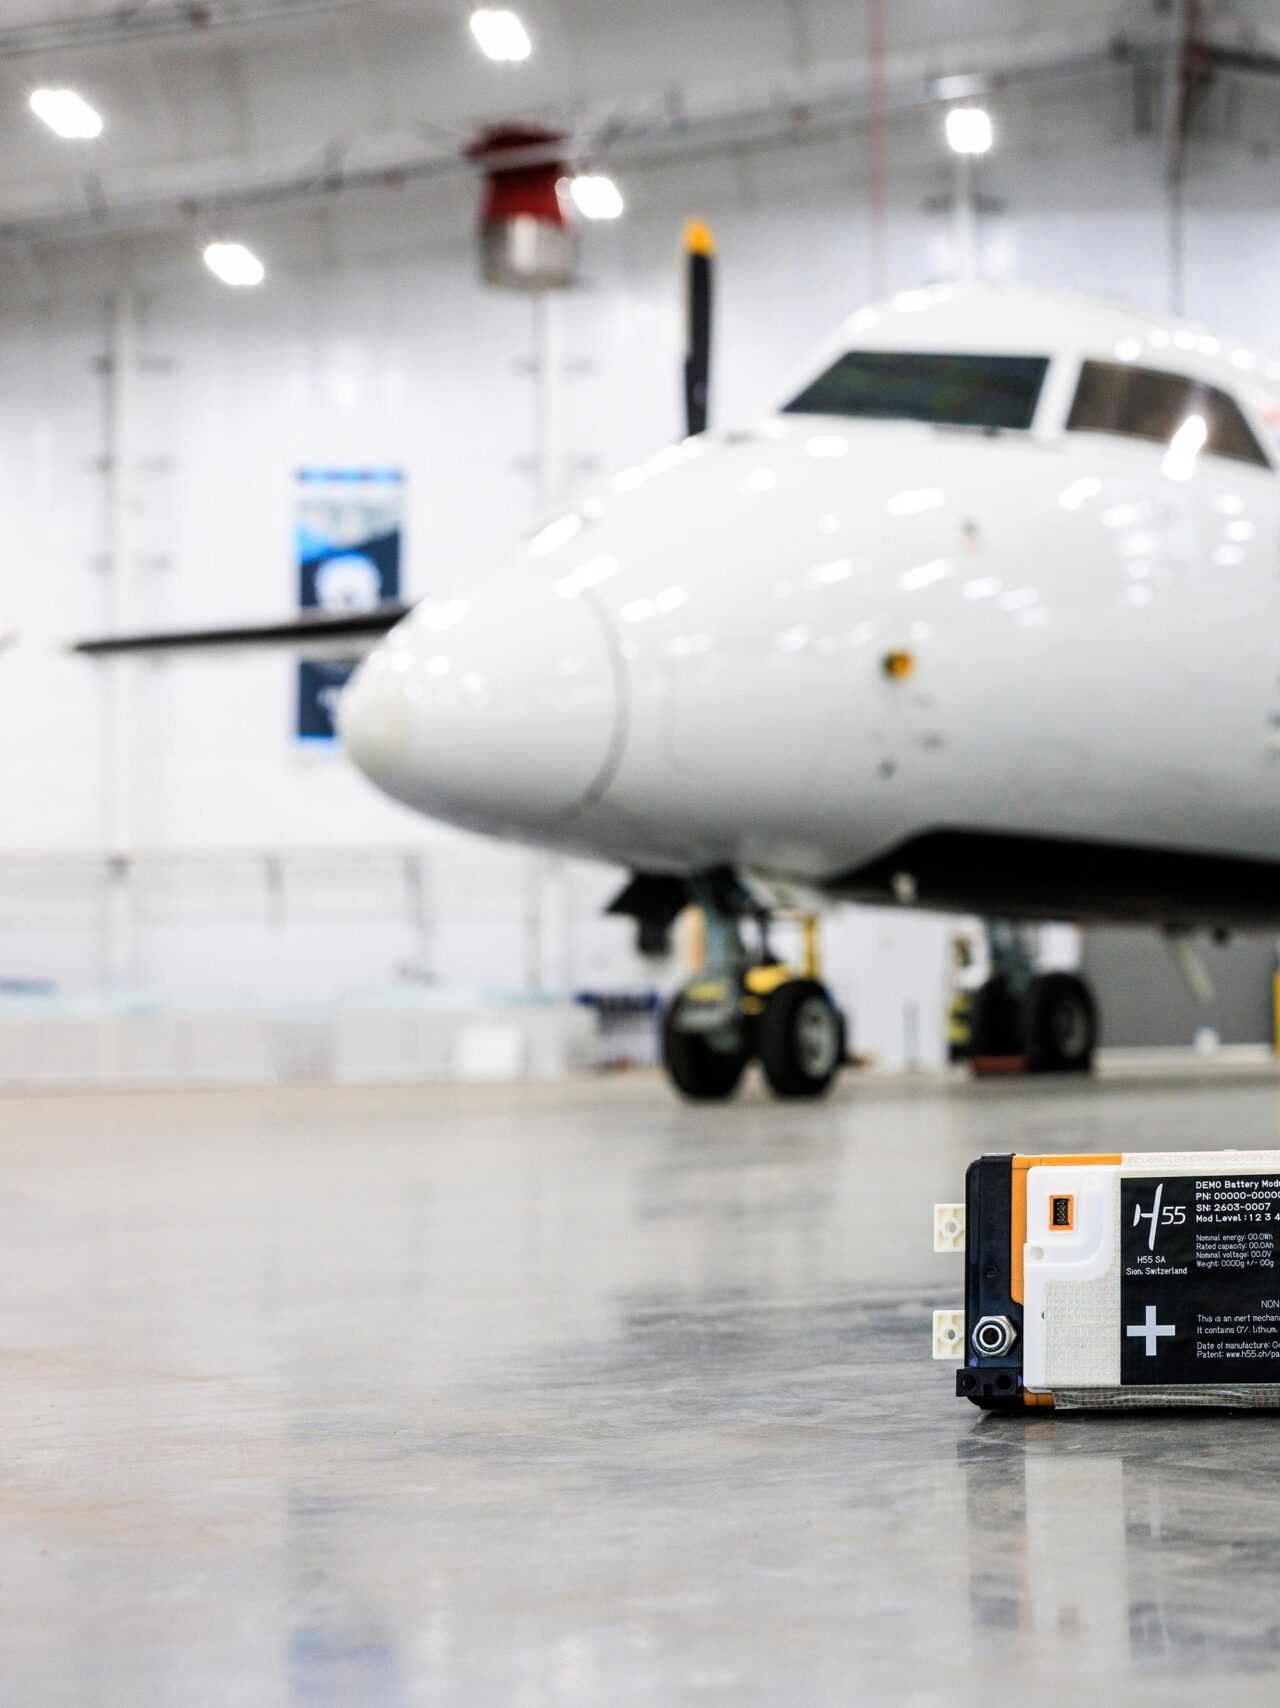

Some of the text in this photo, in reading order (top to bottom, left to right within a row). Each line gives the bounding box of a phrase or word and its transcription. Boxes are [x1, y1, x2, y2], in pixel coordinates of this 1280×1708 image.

[1196, 1181, 1221, 1189] DEMO
[1225, 1180, 1259, 1190] Battery
[1196, 1192, 1211, 1200] PN:
[1196, 1202, 1271, 1212] SN: 2603-0007
[1196, 1214, 1213, 1223] Mod
[1215, 1213, 1242, 1222] Level
[1196, 1234, 1221, 1242] Nominal
[1222, 1234, 1247, 1242] energy:
[1196, 1242, 1217, 1251] Rated
[1217, 1243, 1248, 1251] capacity:
[1137, 1255, 1166, 1264] H55 SA
[1196, 1251, 1221, 1259] Nominal
[1222, 1251, 1249, 1260] voltage:
[1196, 1259, 1220, 1269] Weight:
[1145, 1266, 1188, 1275] Switzerland
[1197, 1314, 1213, 1323] This
[1233, 1313, 1251, 1322] inert
[1197, 1326, 1203, 1334] It
[1204, 1326, 1235, 1334] contains
[1197, 1341, 1215, 1350] Date
[1216, 1341, 1224, 1349] of
[1225, 1341, 1271, 1350] manufacture:
[1197, 1350, 1224, 1359] Patent:
